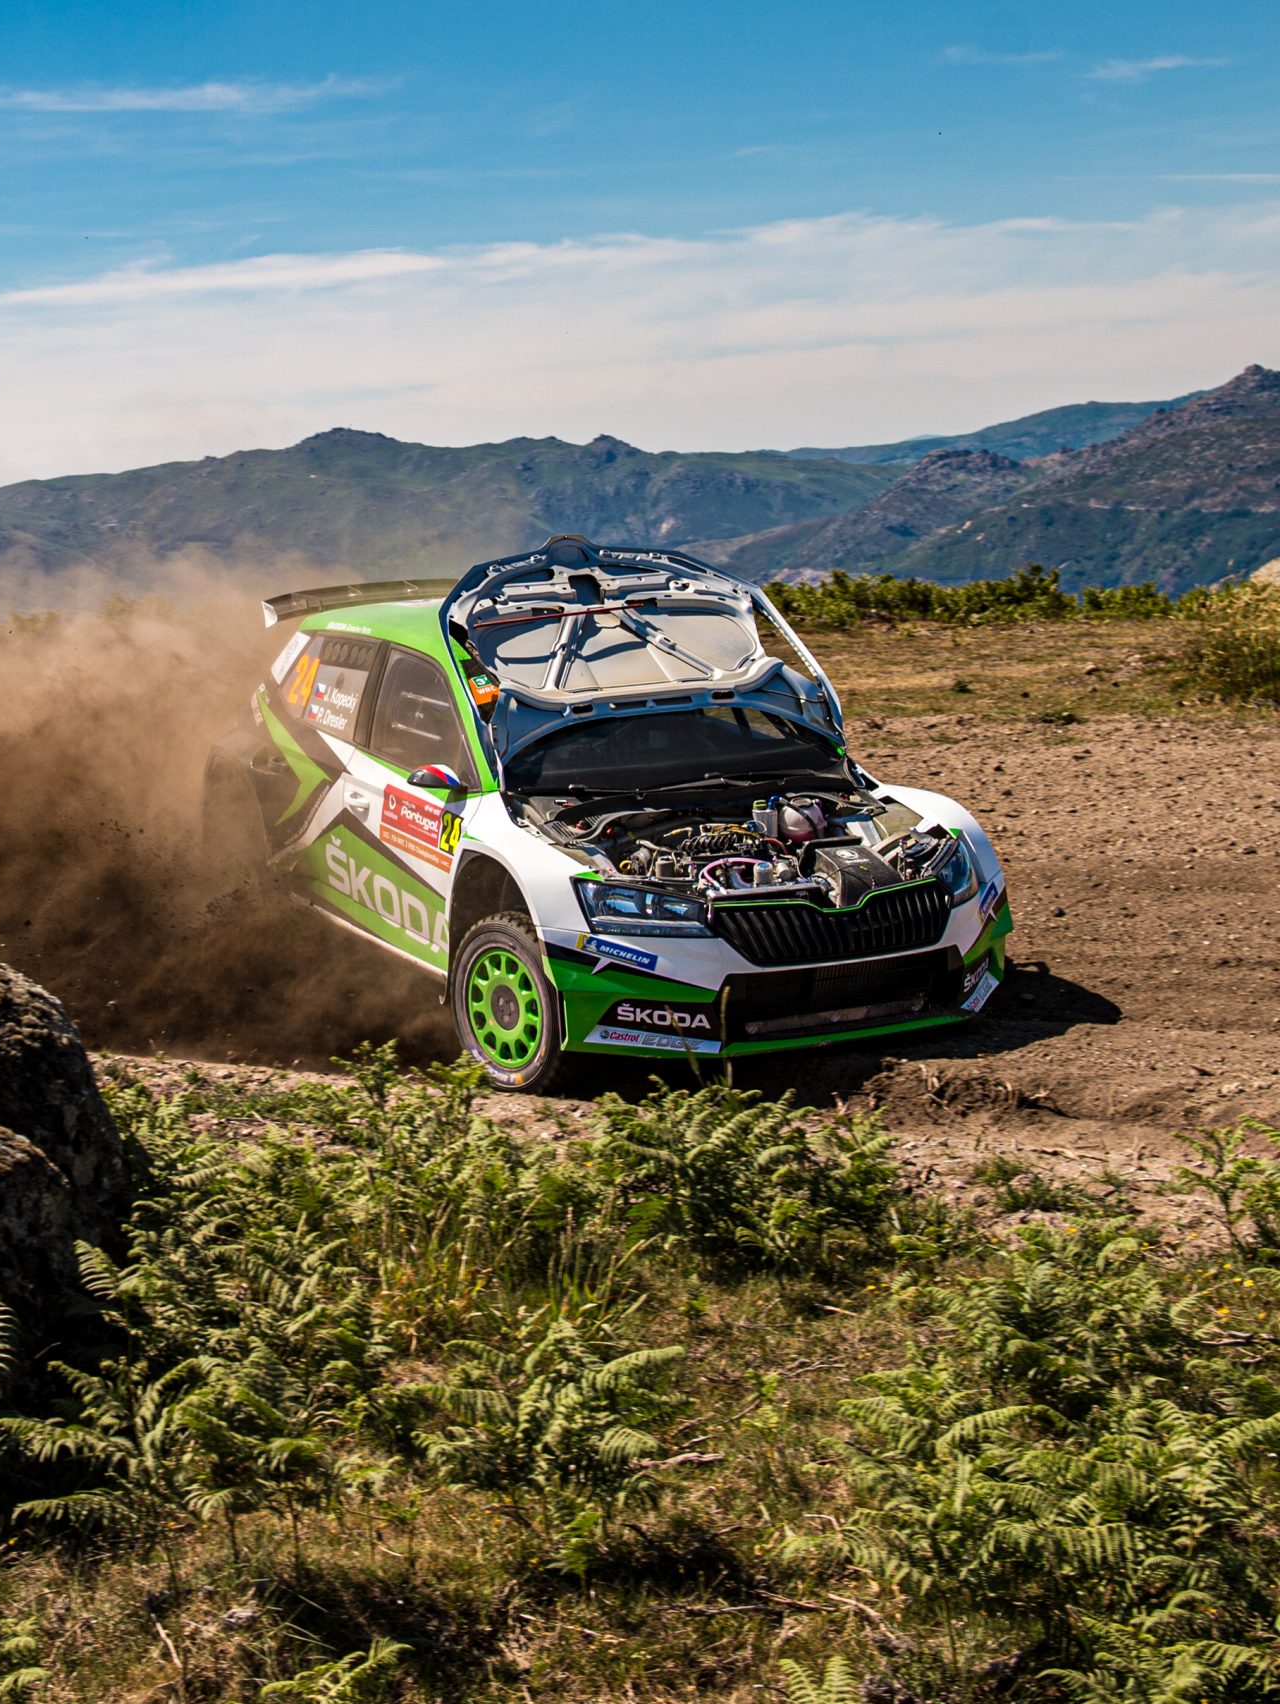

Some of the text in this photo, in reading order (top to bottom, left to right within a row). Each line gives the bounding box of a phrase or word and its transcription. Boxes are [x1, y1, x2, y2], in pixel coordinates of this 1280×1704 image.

[286, 654, 320, 706] 24
[324, 686, 357, 713] J. Kopecký
[316, 707, 348, 730] P. Dresler
[401, 805, 439, 832] Portugal
[440, 813, 462, 855] 24
[599, 944, 650, 965] MICHELIN
[617, 1003, 711, 1029] ŠKODA
[609, 1030, 704, 1051] Castrol EDGE
